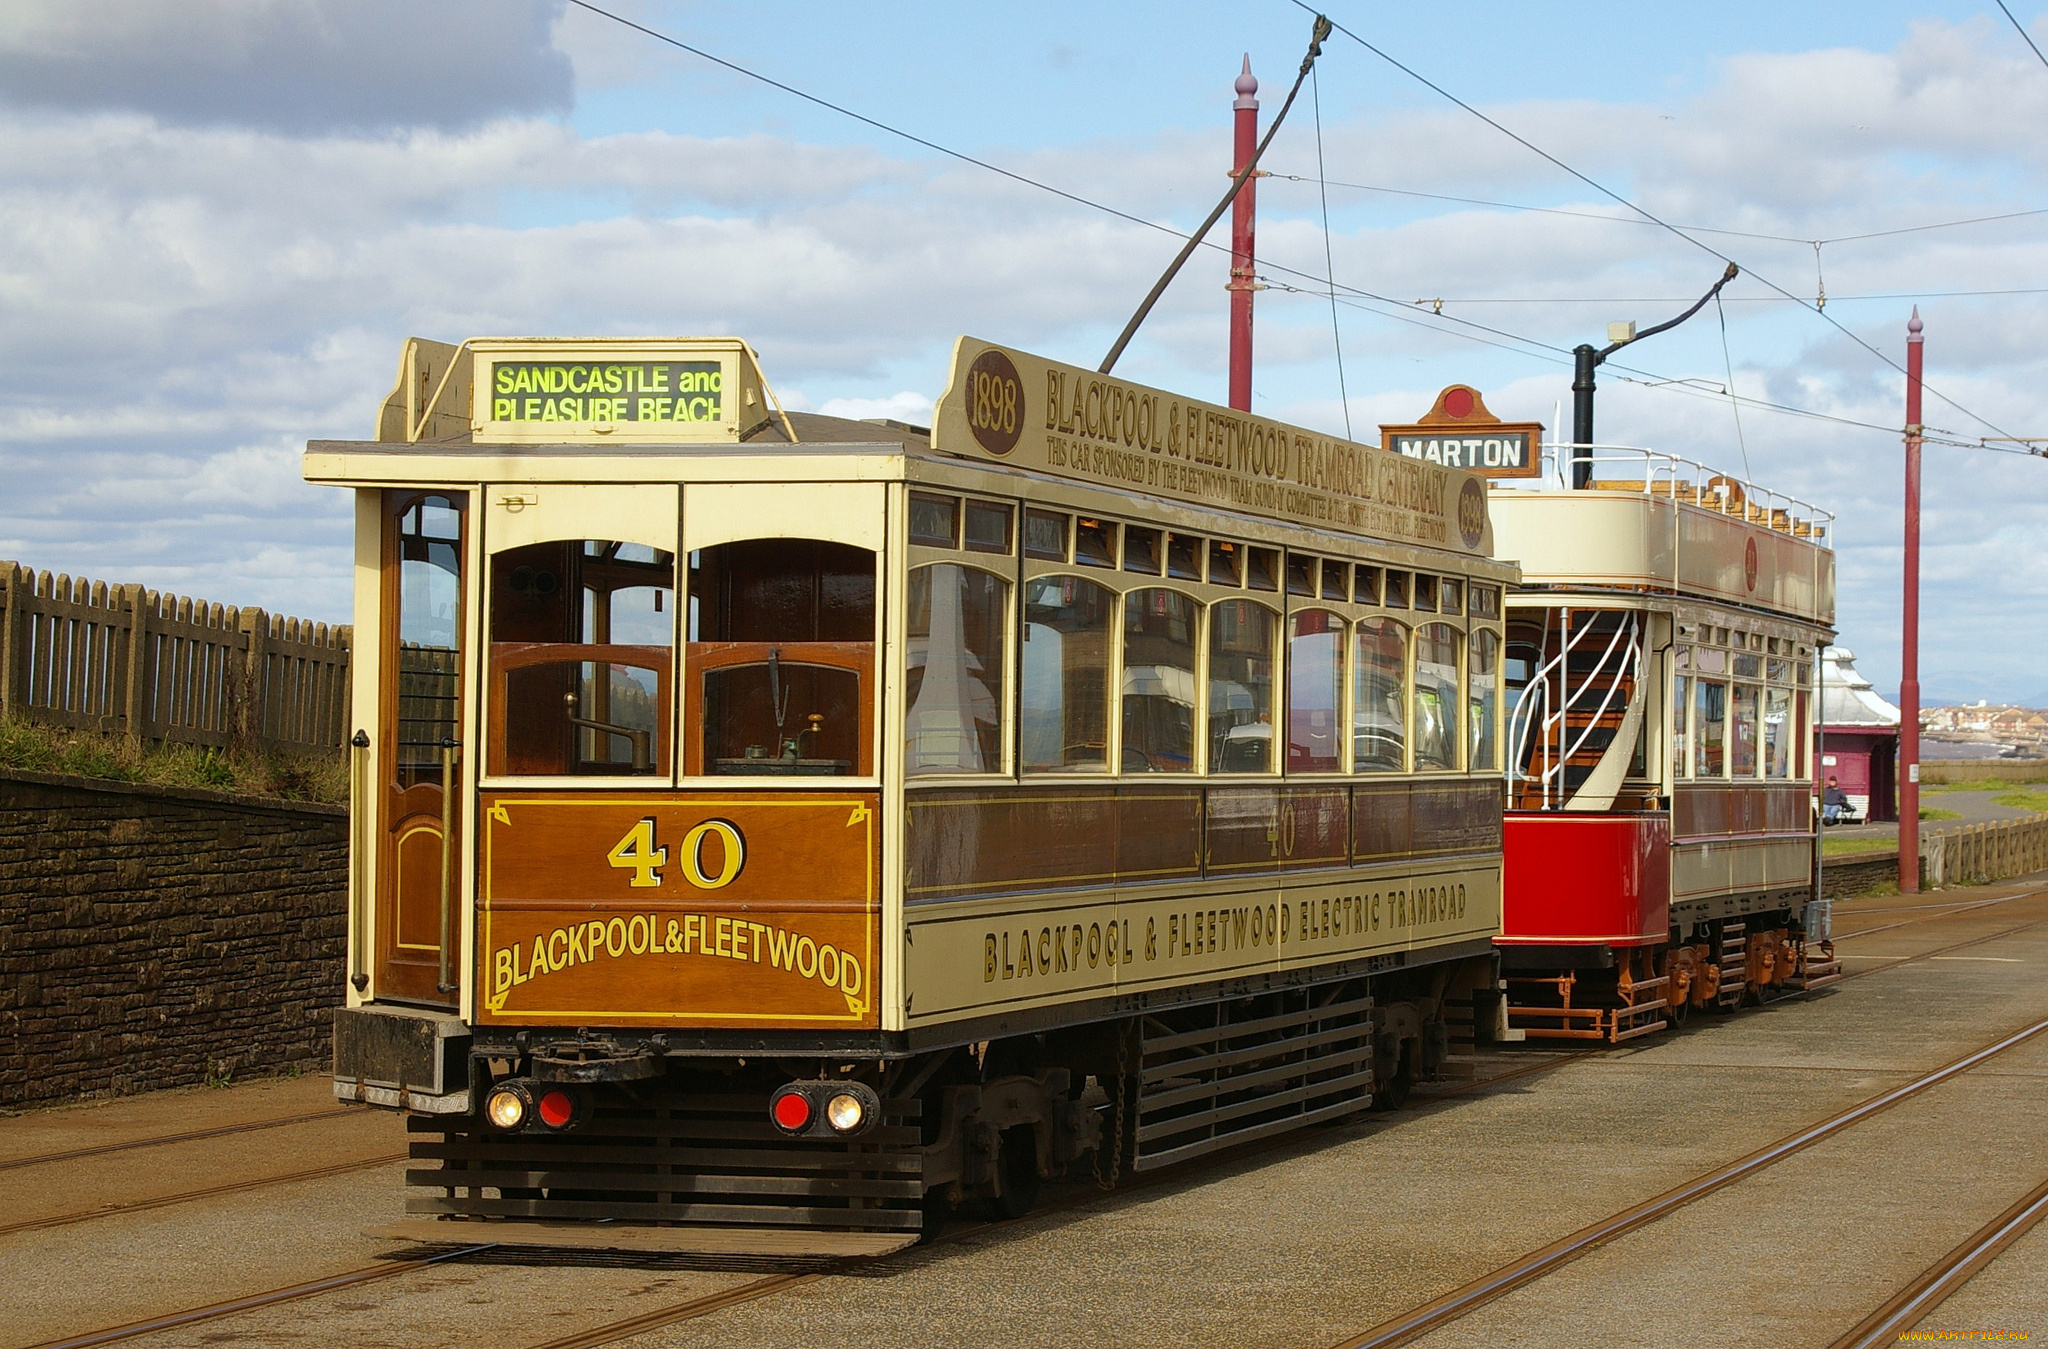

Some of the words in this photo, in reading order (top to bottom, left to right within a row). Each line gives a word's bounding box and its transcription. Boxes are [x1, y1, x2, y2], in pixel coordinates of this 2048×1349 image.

[494, 397, 628, 421] PLEASURE
[496, 365, 669, 393] SANDCASTLE
[971, 371, 1017, 434] 1898
[1046, 369, 1163, 454] BLACKPOOL
[1168, 401, 1182, 457] &
[1185, 406, 1288, 480] FLEETWOOD
[1295, 435, 1373, 499] TRAMROAD
[1378, 457, 1448, 517] CENTENARY
[1047, 435, 1066, 467] THIS
[1070, 441, 1091, 472] CAR
[1093, 445, 1145, 483] SPONSORED
[1148, 457, 1161, 487] BY
[1163, 461, 1178, 490] THE
[1180, 465, 1227, 500] FLEETWOOD
[1230, 475, 1252, 505] TRAM
[1401, 439, 1521, 467] MARTON
[606, 815, 748, 889] 40
[1267, 803, 1296, 857] 40
[984, 919, 1133, 982] BLACKPOOL
[1144, 916, 1157, 961] &
[1168, 903, 1291, 959] FLEETWOOD
[1299, 893, 1380, 941] ELECTRIC
[1387, 883, 1466, 928] TRAMROAD
